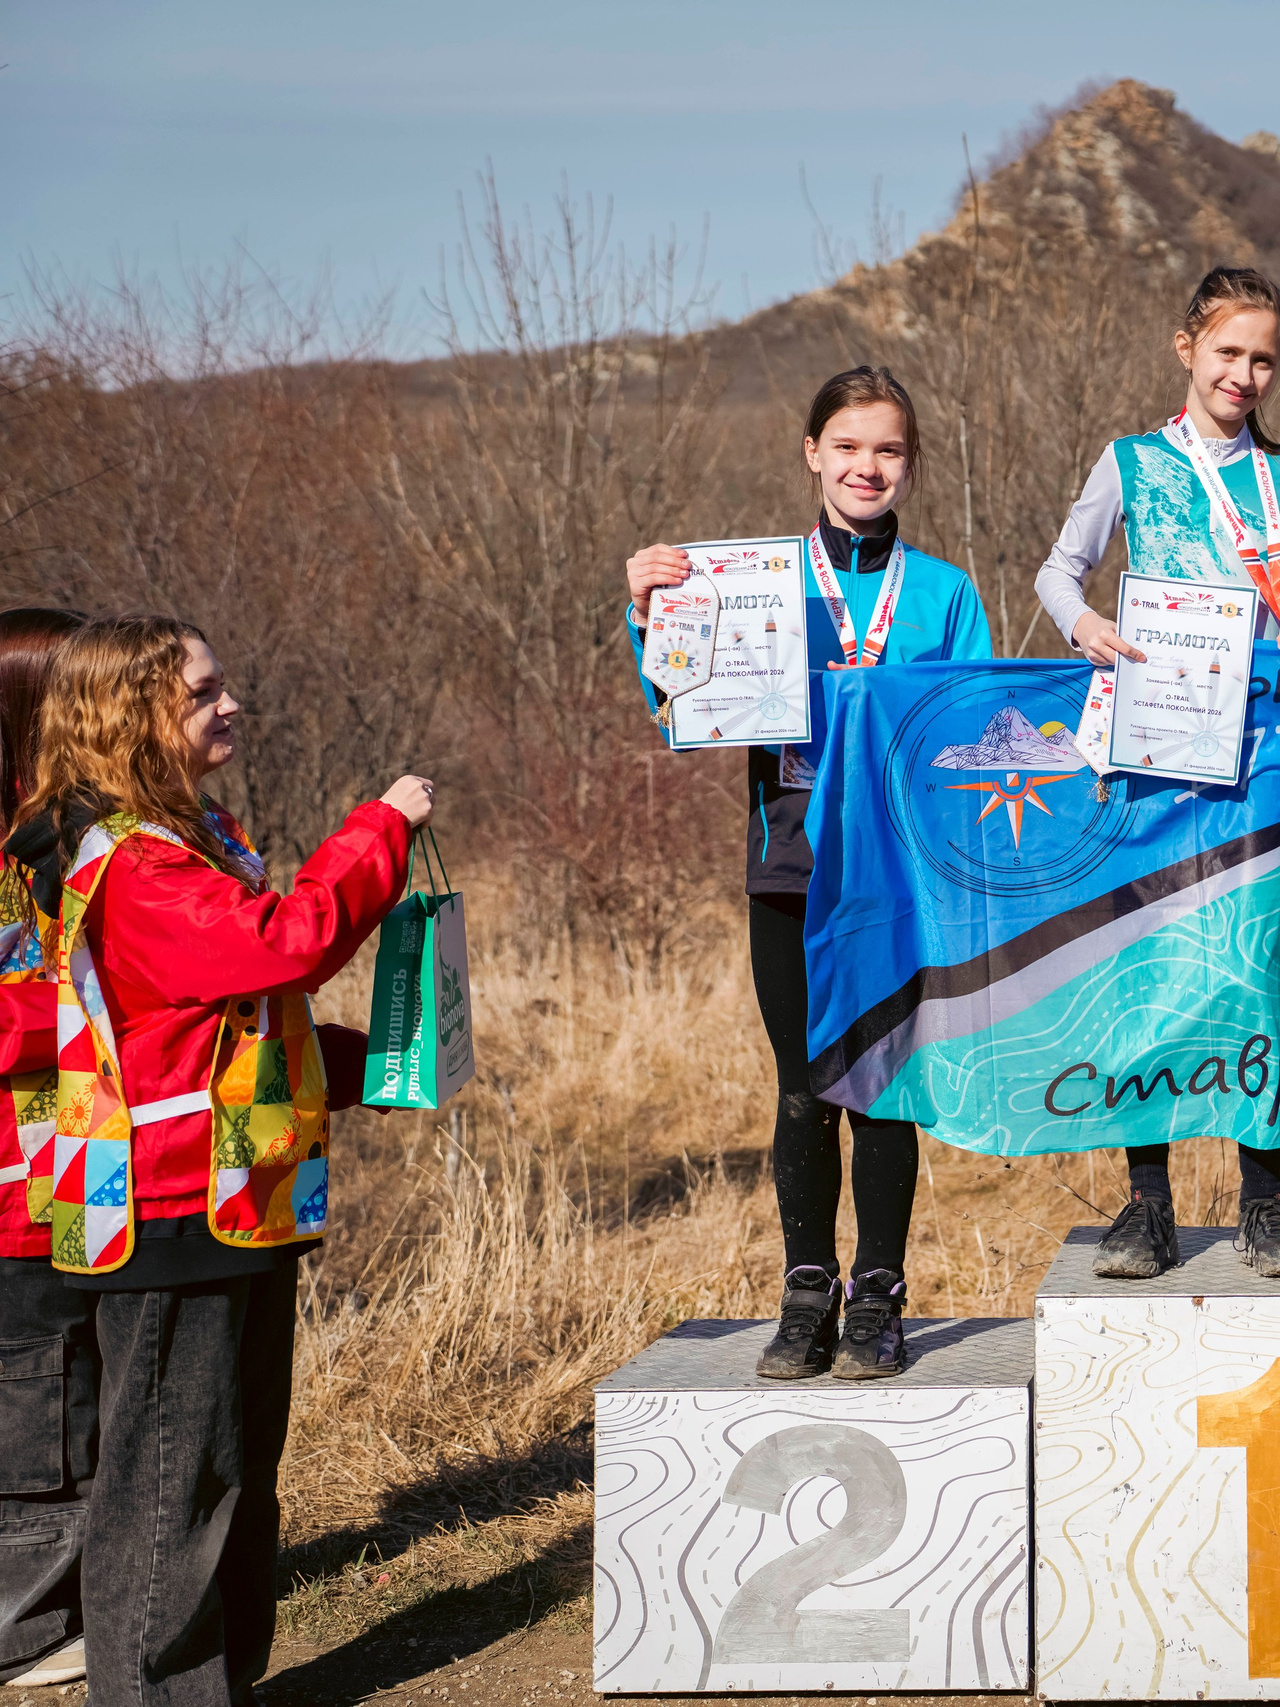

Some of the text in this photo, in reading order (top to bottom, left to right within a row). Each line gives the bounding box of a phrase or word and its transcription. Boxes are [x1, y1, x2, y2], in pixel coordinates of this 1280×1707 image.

[1260, 470, 1277, 520] ЛЕРМОНТОВ
[812, 542, 822, 562] 2026
[720, 594, 784, 610] МОТА
[820, 570, 844, 620] ЛЕРМОНТОВ
[1135, 628, 1230, 652] ГРАМОТА
[727, 668, 768, 678] ПОКОЛЕНИЙ
[770, 668, 785, 676] 2026
[1008, 690, 1016, 698] N
[1166, 694, 1190, 702] O-TRAIL
[1133, 700, 1222, 716] ЭСТАФЕТА ПОКОЛЕНИЙ 2026
[926, 783, 937, 792] W
[1013, 856, 1020, 866] S
[440, 1000, 464, 1036] bionova
[382, 968, 407, 1100] ПОДПИШИСЬ
[713, 1424, 910, 1664] 2
